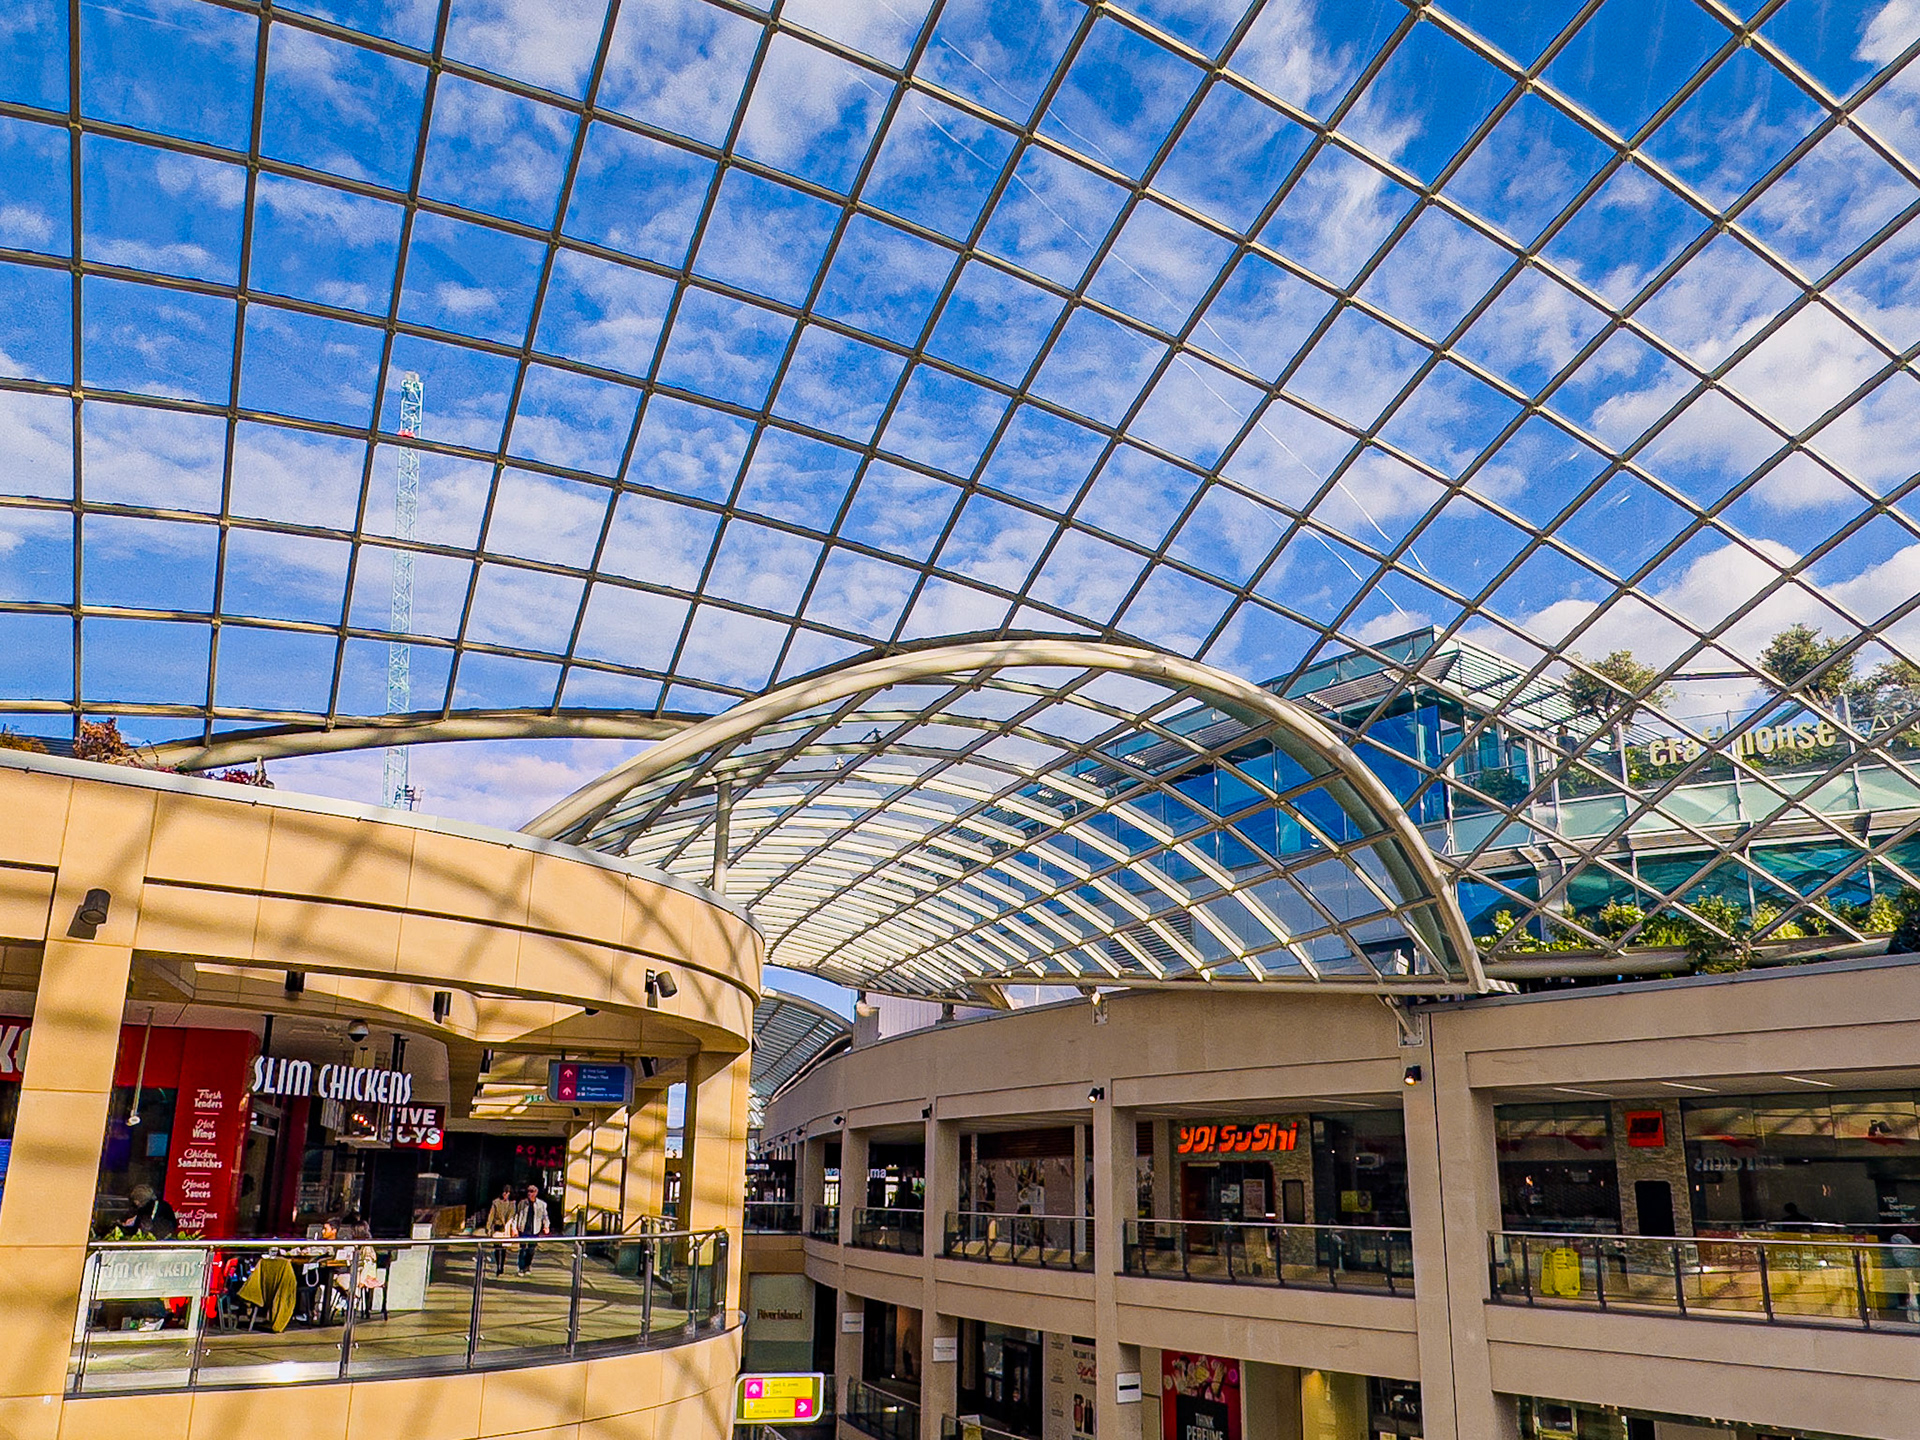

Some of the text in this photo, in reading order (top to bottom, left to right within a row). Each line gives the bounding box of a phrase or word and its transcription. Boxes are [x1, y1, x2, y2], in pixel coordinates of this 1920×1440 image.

[252, 1055, 412, 1105] SLIM CHICKENS
[197, 1089, 222, 1099] Fresh
[194, 1098, 223, 1108] Tenders
[196, 1119, 215, 1129] Hot
[193, 1128, 216, 1139] Wings
[184, 1148, 217, 1159] Chicken
[178, 1158, 222, 1168] Sandwiches
[185, 1188, 211, 1198] Sauces
